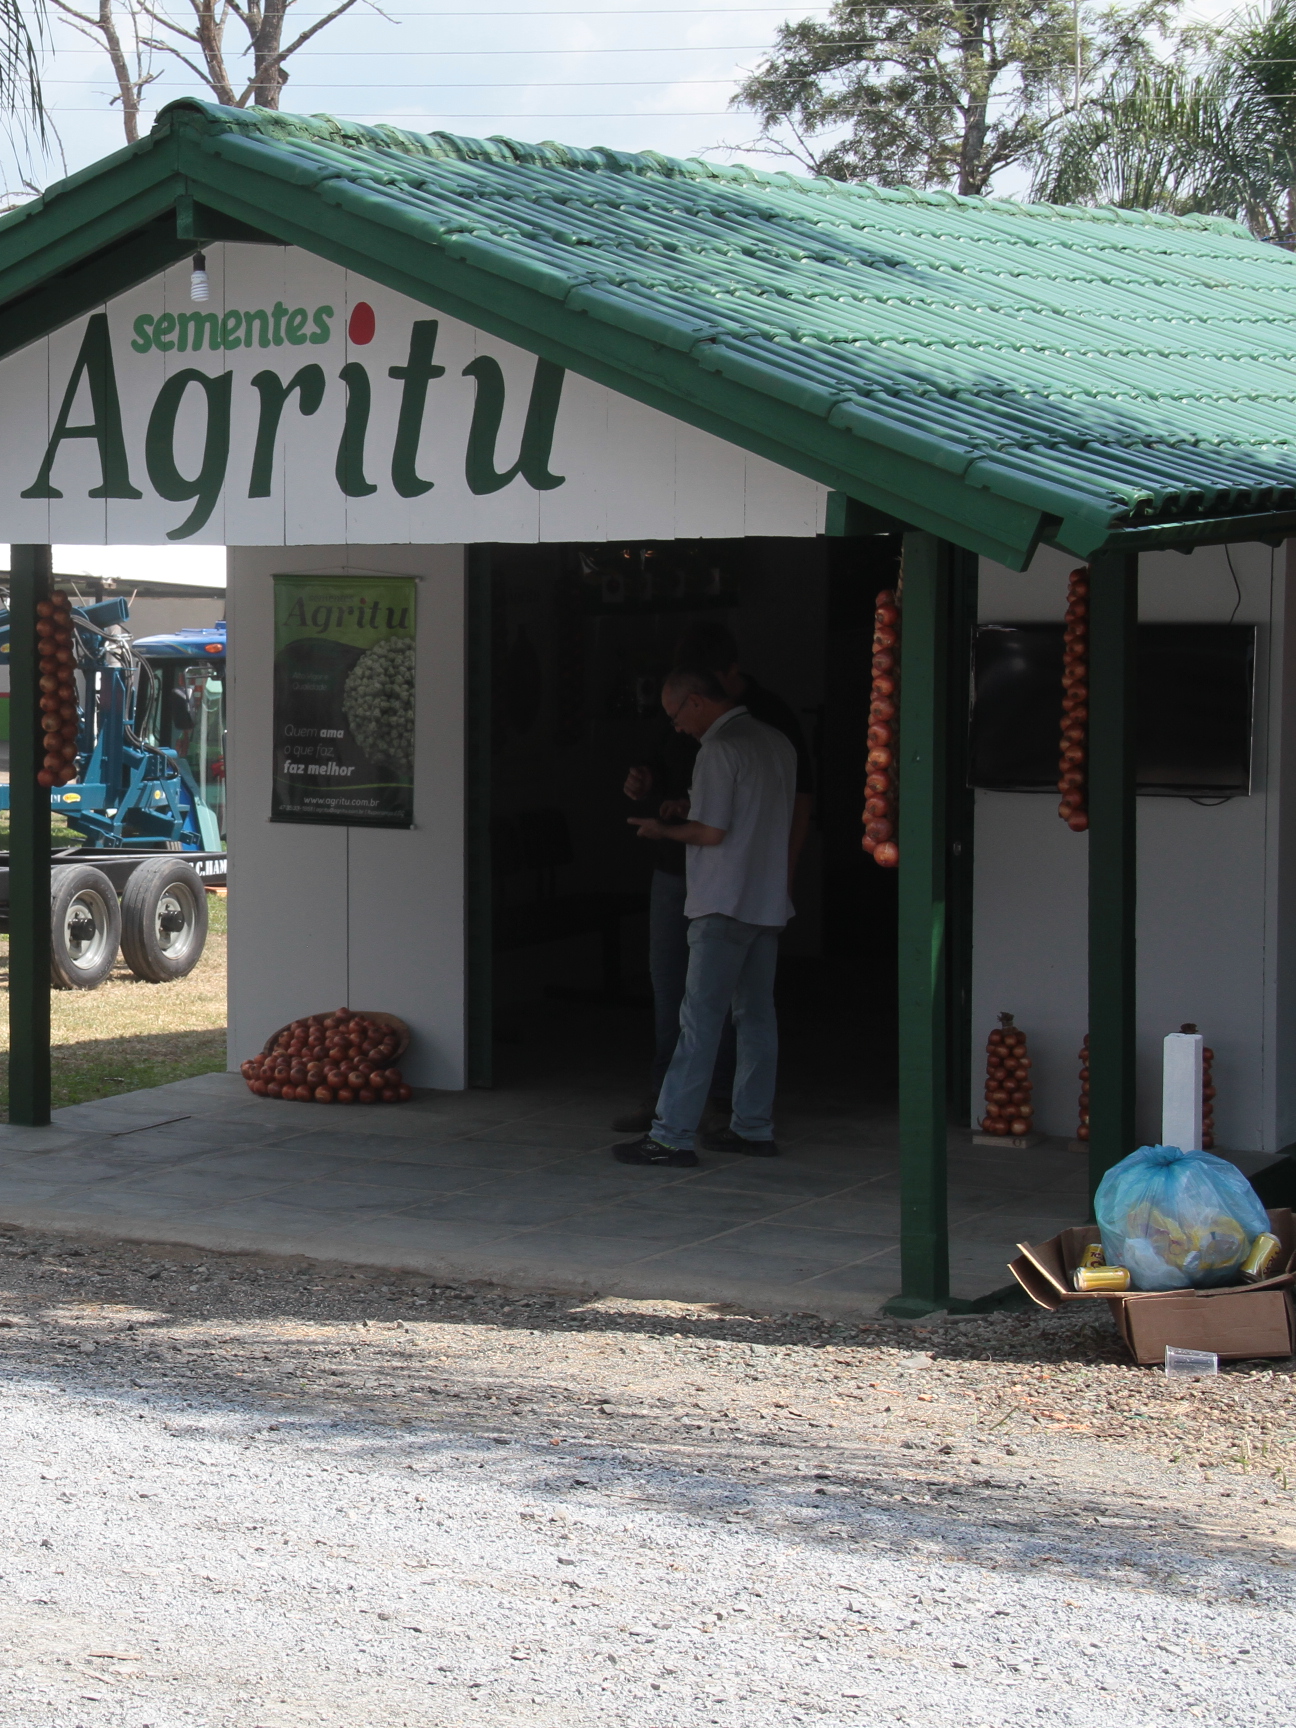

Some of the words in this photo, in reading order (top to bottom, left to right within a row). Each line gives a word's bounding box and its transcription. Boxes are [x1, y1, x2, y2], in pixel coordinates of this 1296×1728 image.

[130, 301, 334, 354] sementes
[20, 302, 566, 540] Agritu
[283, 596, 410, 634] Agritu
[284, 723, 317, 737] Quem
[319, 729, 344, 738] ama
[284, 745, 291, 754] o
[293, 745, 314, 758] que
[315, 743, 335, 759] faz,
[283, 759, 305, 774] faz
[307, 761, 355, 777] melhor
[303, 796, 380, 807] www.agritu.com.br
